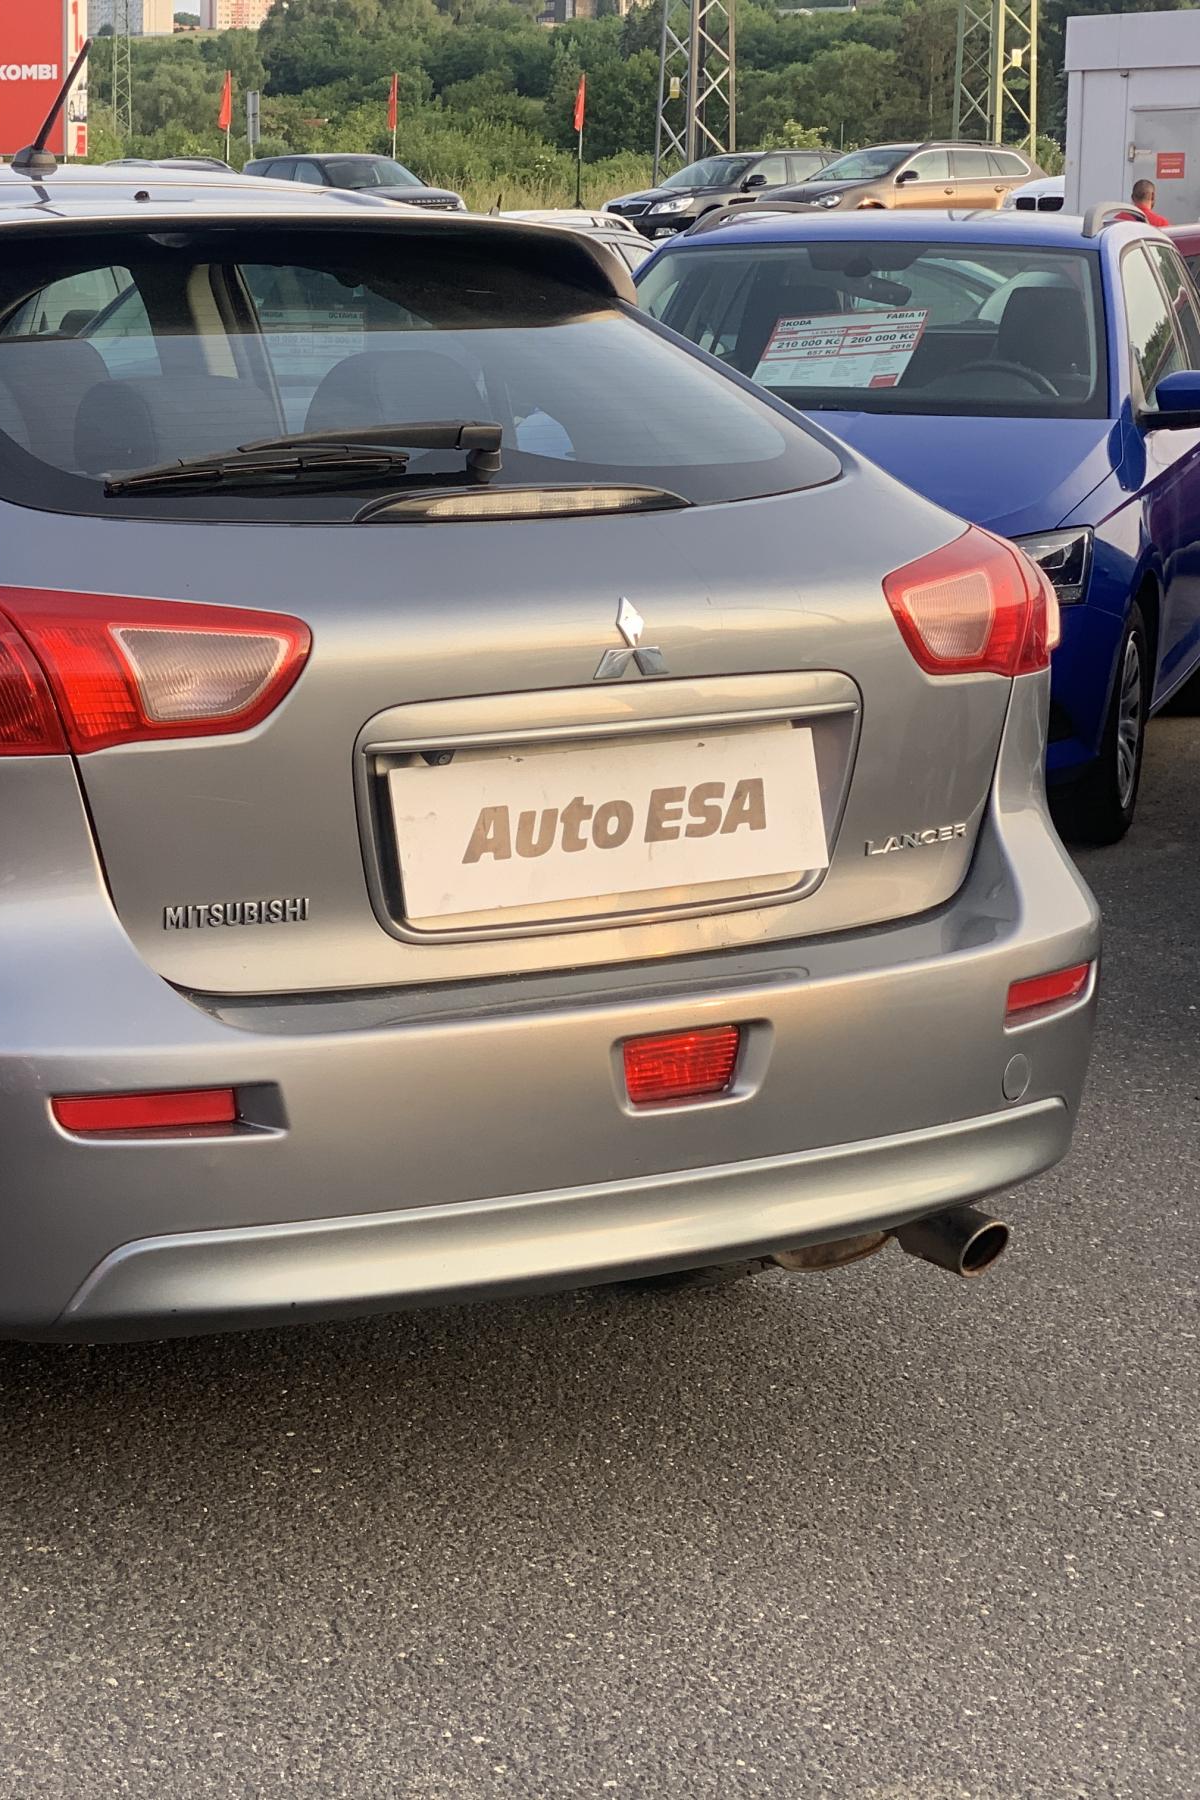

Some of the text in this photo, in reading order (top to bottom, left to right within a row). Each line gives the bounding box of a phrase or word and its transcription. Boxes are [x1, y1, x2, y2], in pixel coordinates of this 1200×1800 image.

[886, 312, 915, 320] FABIA
[777, 337, 841, 349] 210 000 Kč
[850, 332, 916, 343] 260 000 Kč
[462, 778, 766, 864] Auto ESA
[865, 822, 968, 857] LANCER
[163, 897, 310, 931] MITSUBISHI
